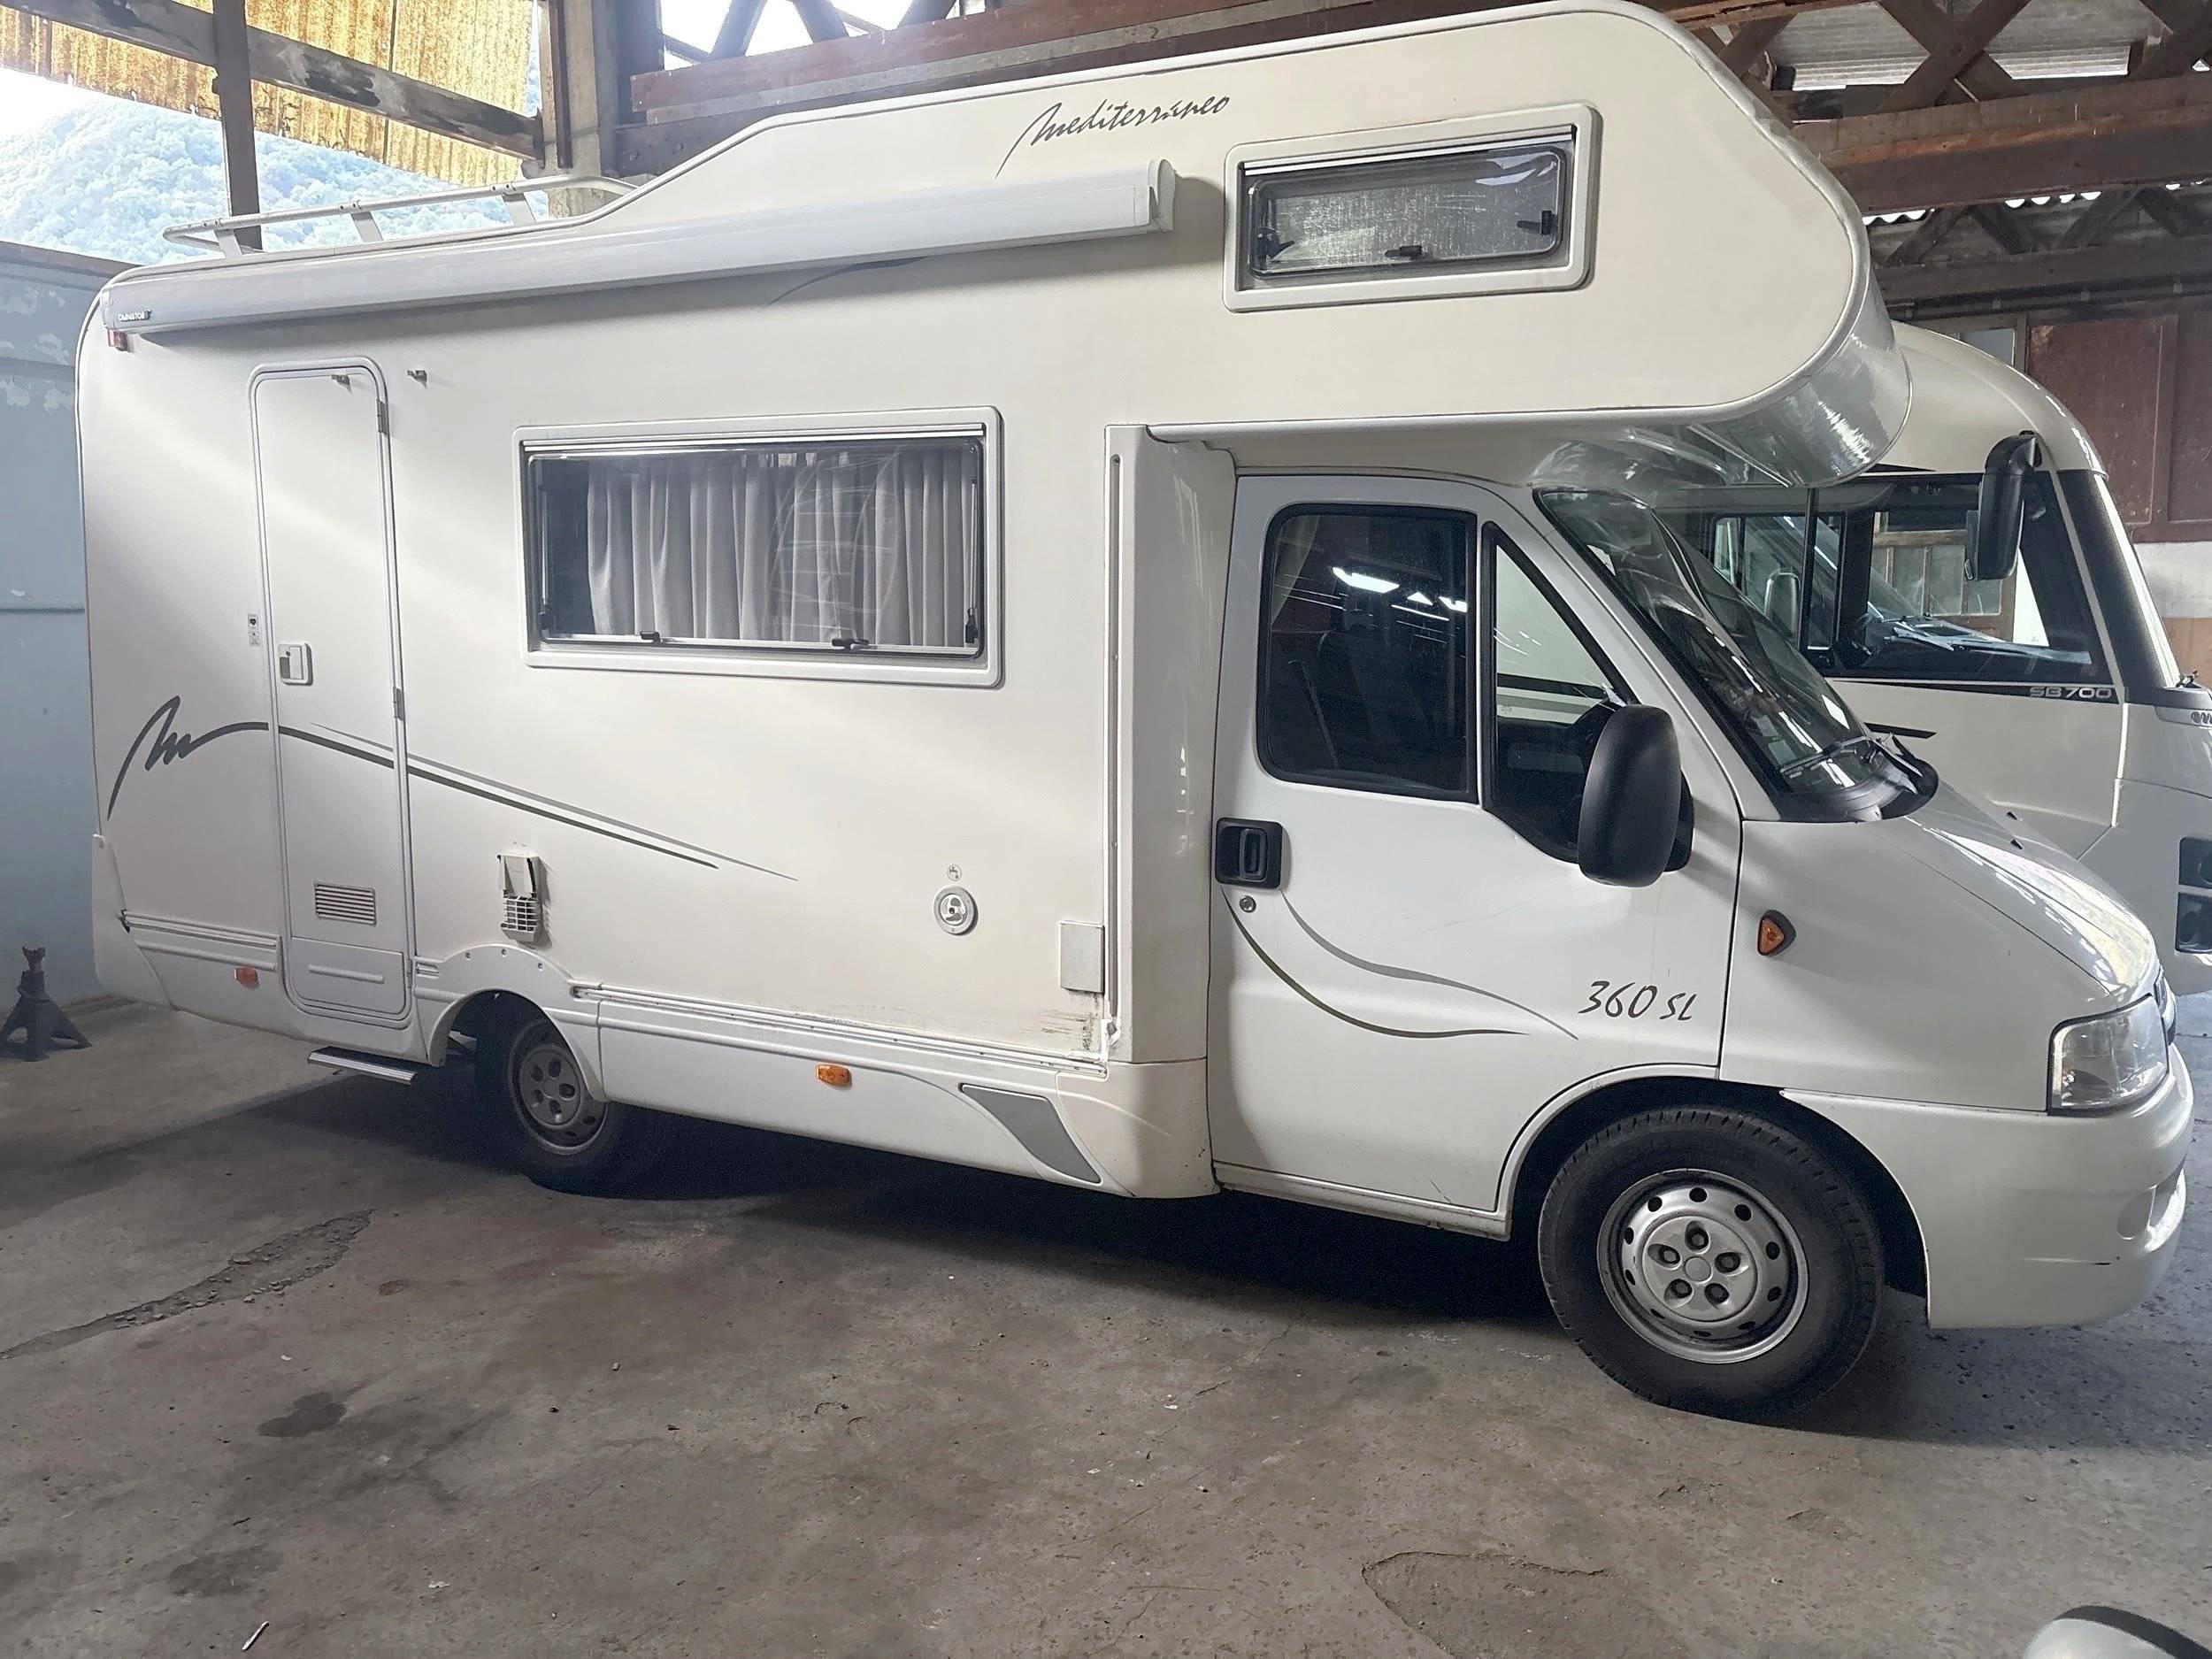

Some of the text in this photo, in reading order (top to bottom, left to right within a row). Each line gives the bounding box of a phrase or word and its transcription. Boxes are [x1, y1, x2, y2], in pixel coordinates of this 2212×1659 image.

[2030, 686, 2112, 699] SB700
[1578, 980, 1697, 1021] 360 SL
